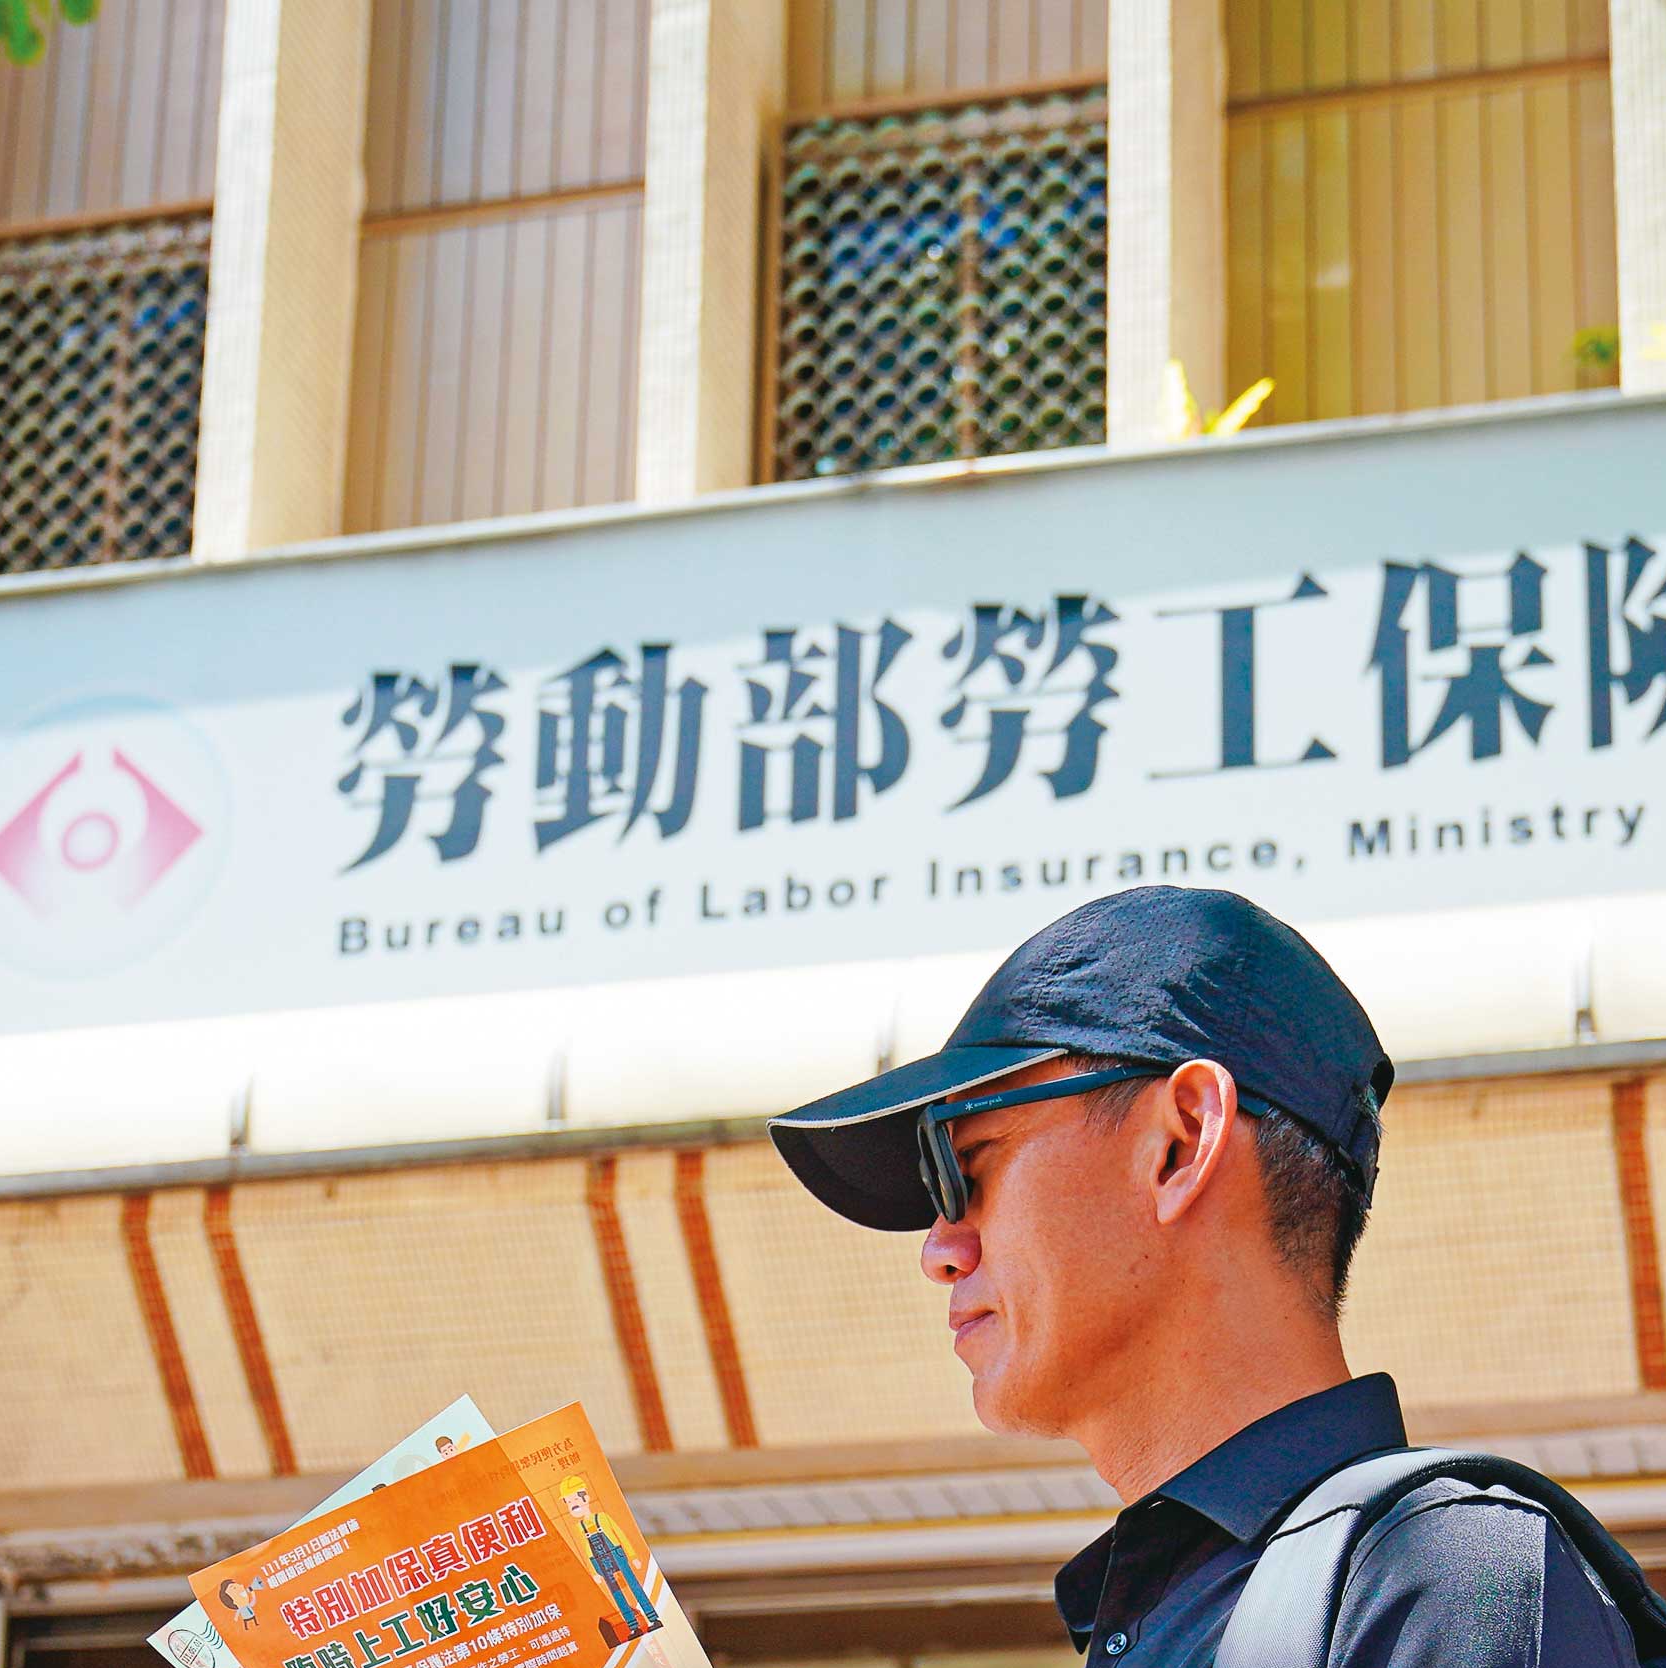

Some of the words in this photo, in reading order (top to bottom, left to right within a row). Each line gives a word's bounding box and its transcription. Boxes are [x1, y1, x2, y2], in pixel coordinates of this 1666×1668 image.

[337, 906, 567, 956] Bureau
[604, 888, 663, 932] of
[702, 872, 889, 920] Labor
[928, 838, 1304, 899] Insurance,
[1348, 802, 1645, 857] Ministry
[282, 1496, 546, 1640] 特別加保真便利
